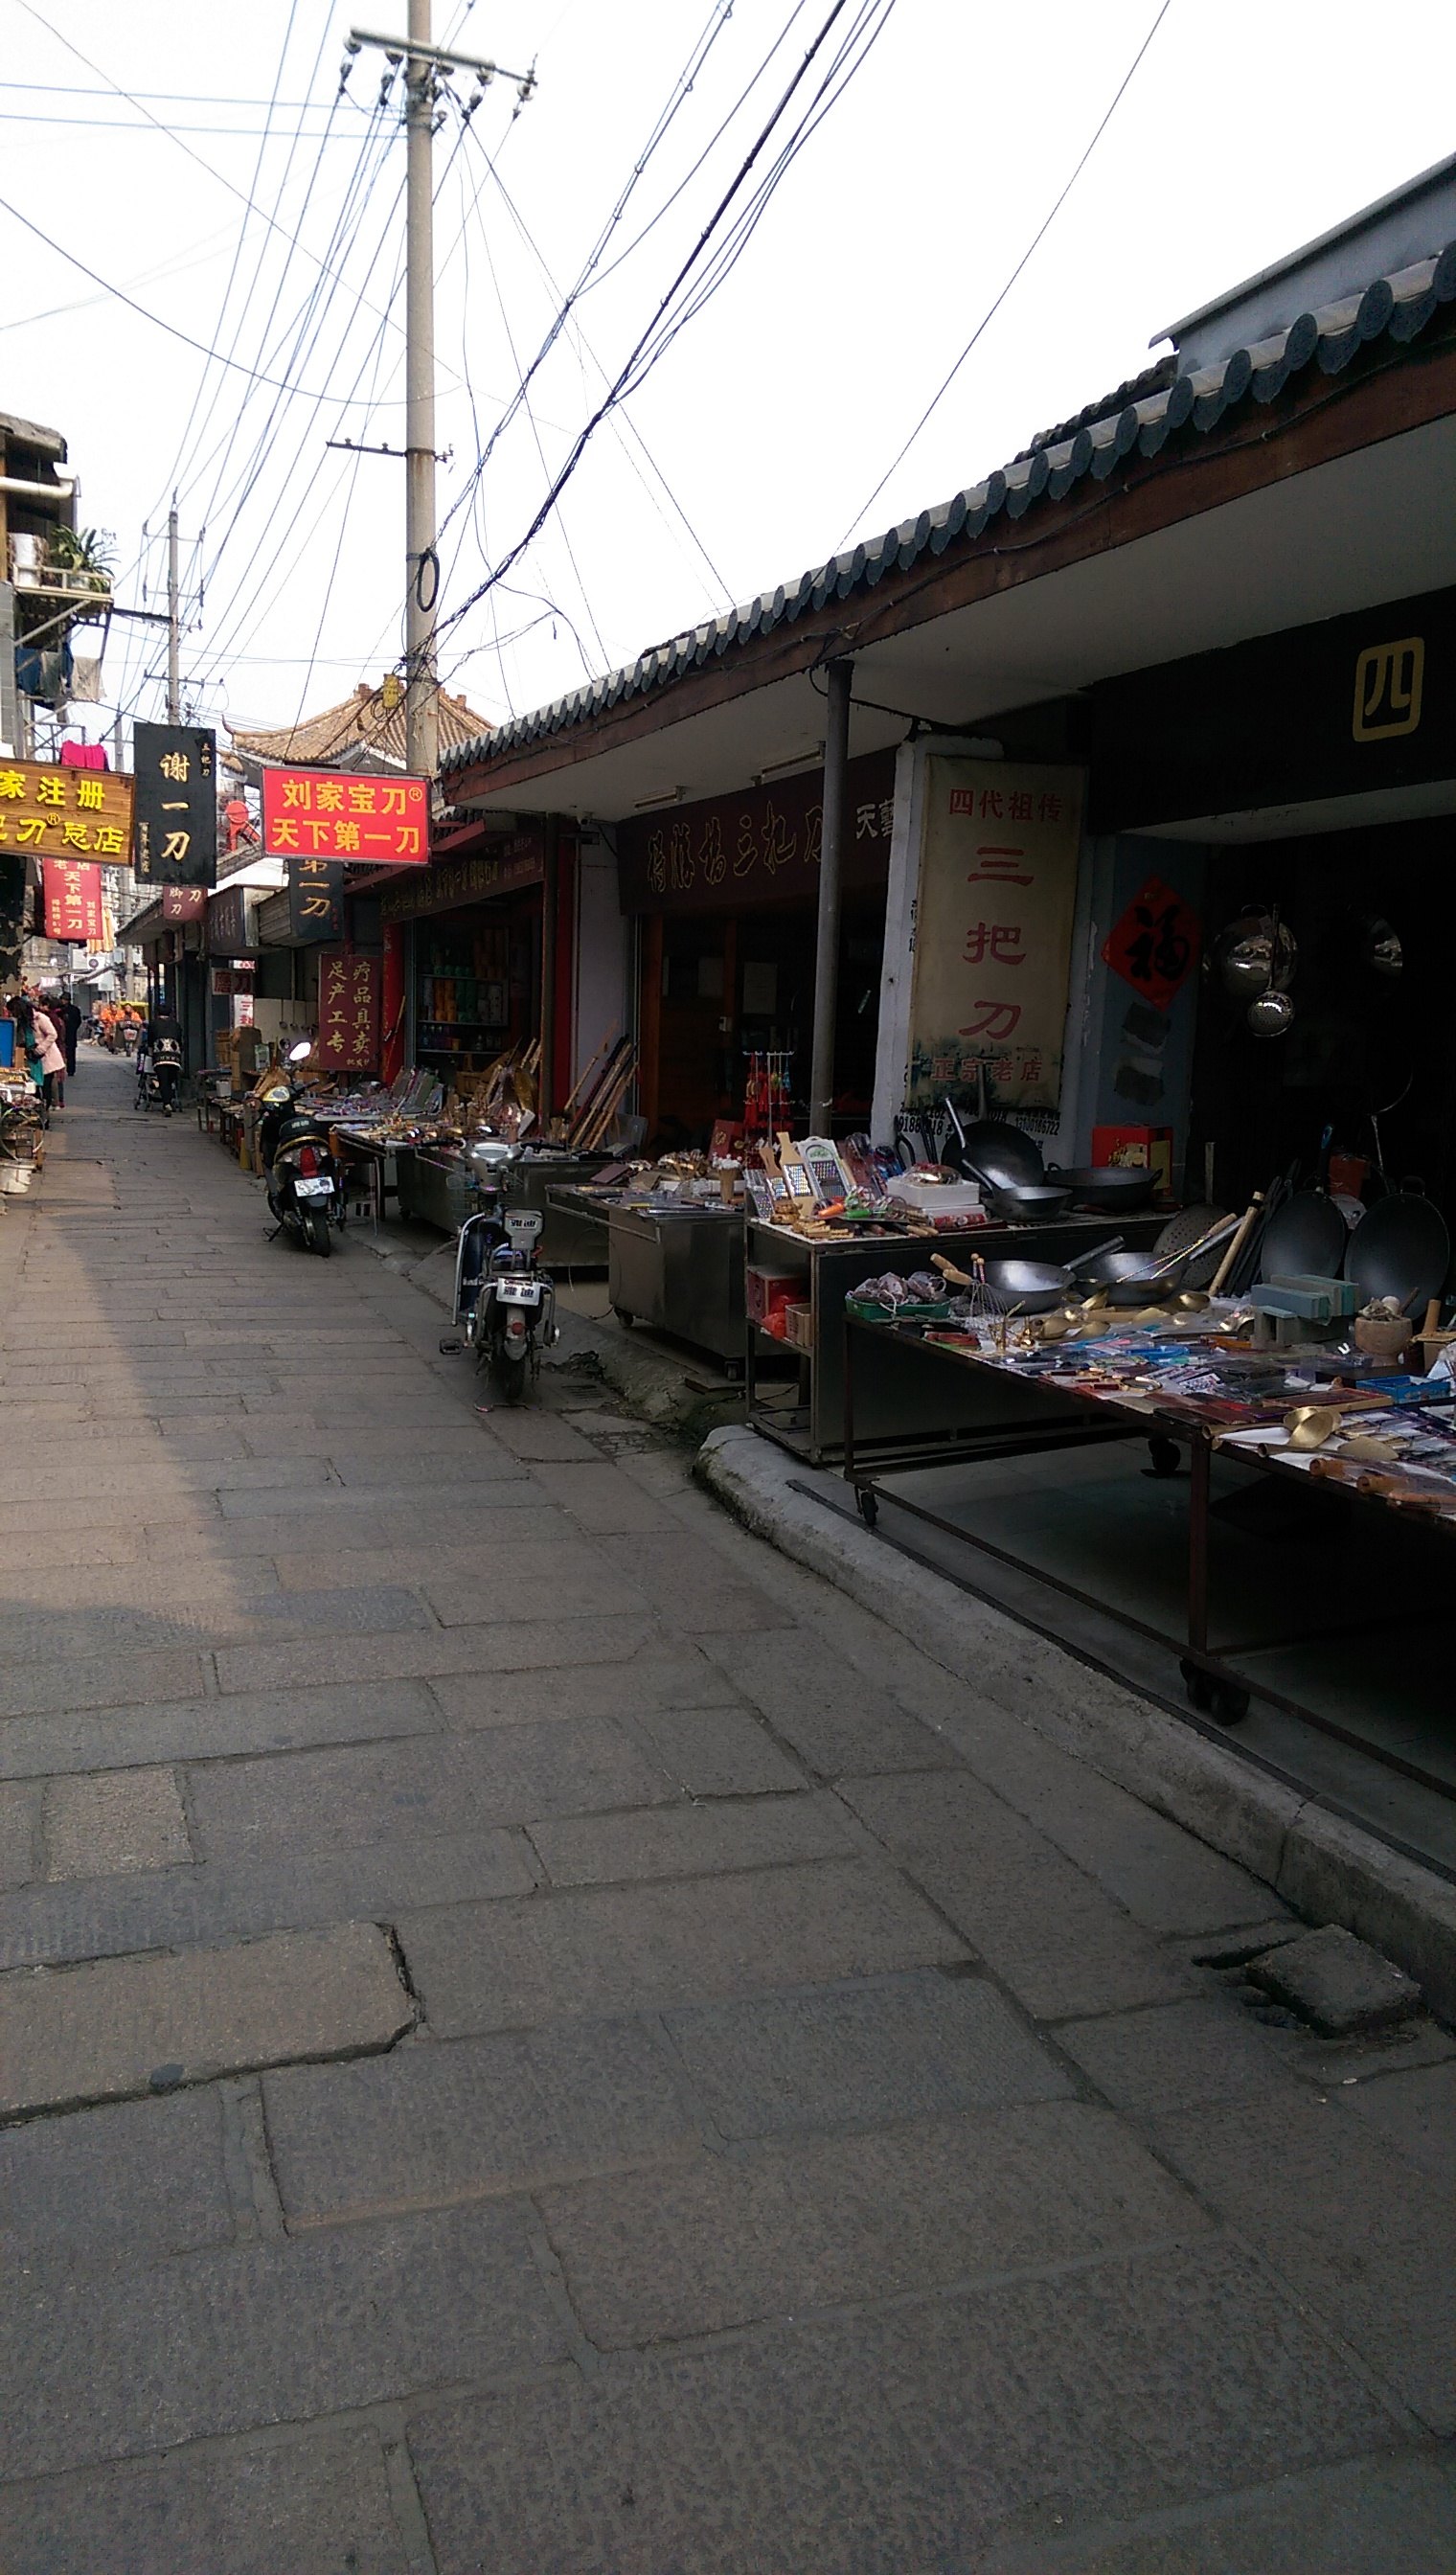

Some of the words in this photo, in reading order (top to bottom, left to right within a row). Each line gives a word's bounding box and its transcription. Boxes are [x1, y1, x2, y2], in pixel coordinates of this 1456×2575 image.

[1352, 636, 1425, 742] 四
[0, 770, 105, 809] 家注册
[159, 752, 191, 860] 谢一刀
[948, 787, 1063, 822] 四代祖传
[271, 818, 420, 854] 天下第一刀
[63, 871, 84, 929] 天下第一刀
[959, 846, 1035, 1041] 三把刀
[930, 1058, 1043, 1082] 正宗老店
